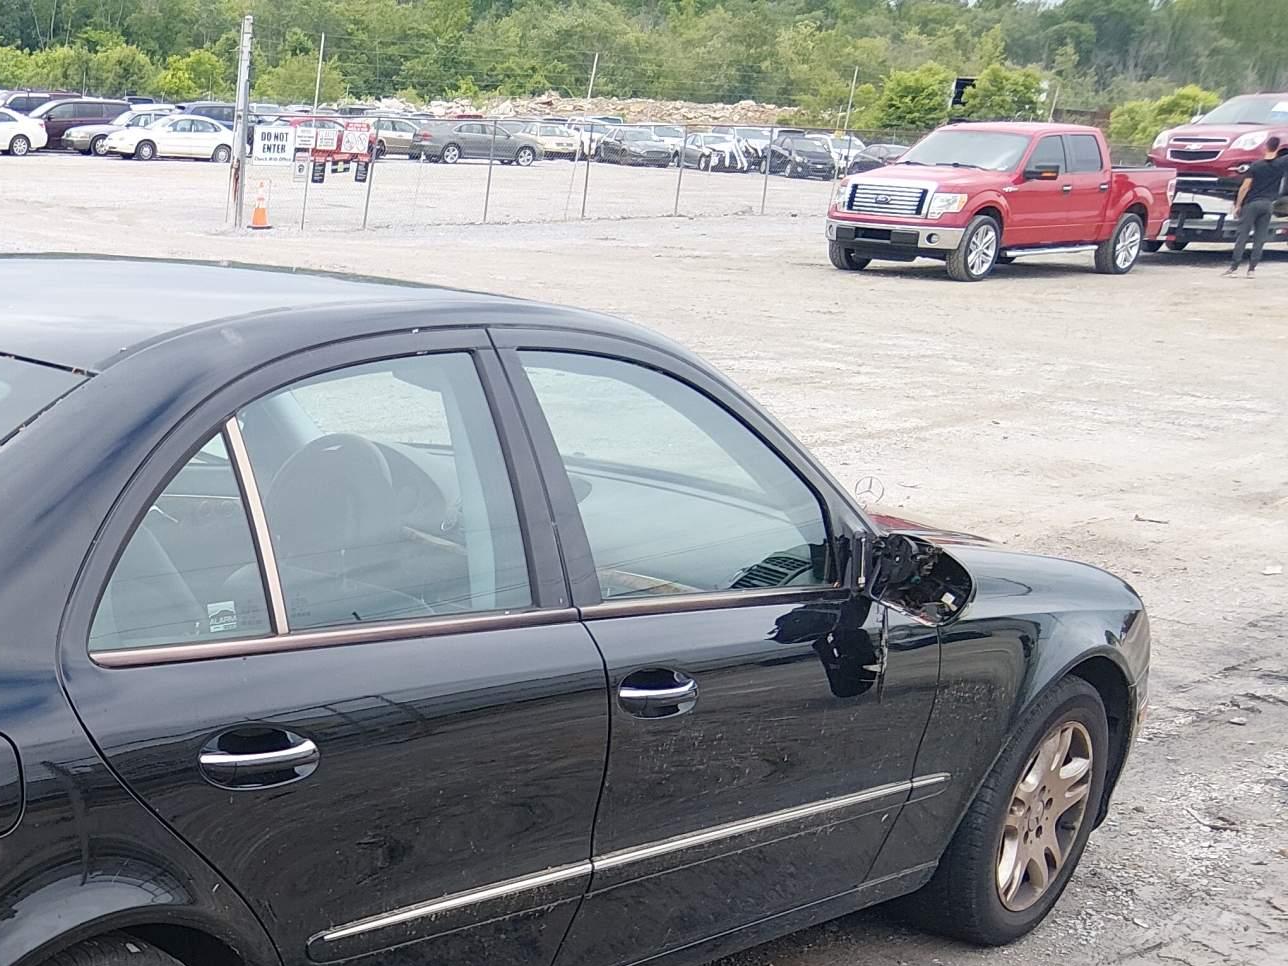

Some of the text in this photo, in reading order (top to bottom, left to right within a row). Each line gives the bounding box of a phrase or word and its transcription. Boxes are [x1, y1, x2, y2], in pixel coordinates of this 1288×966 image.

[261, 131, 272, 142] DO
[274, 131, 289, 142] NOT
[262, 144, 286, 153] ENTER
